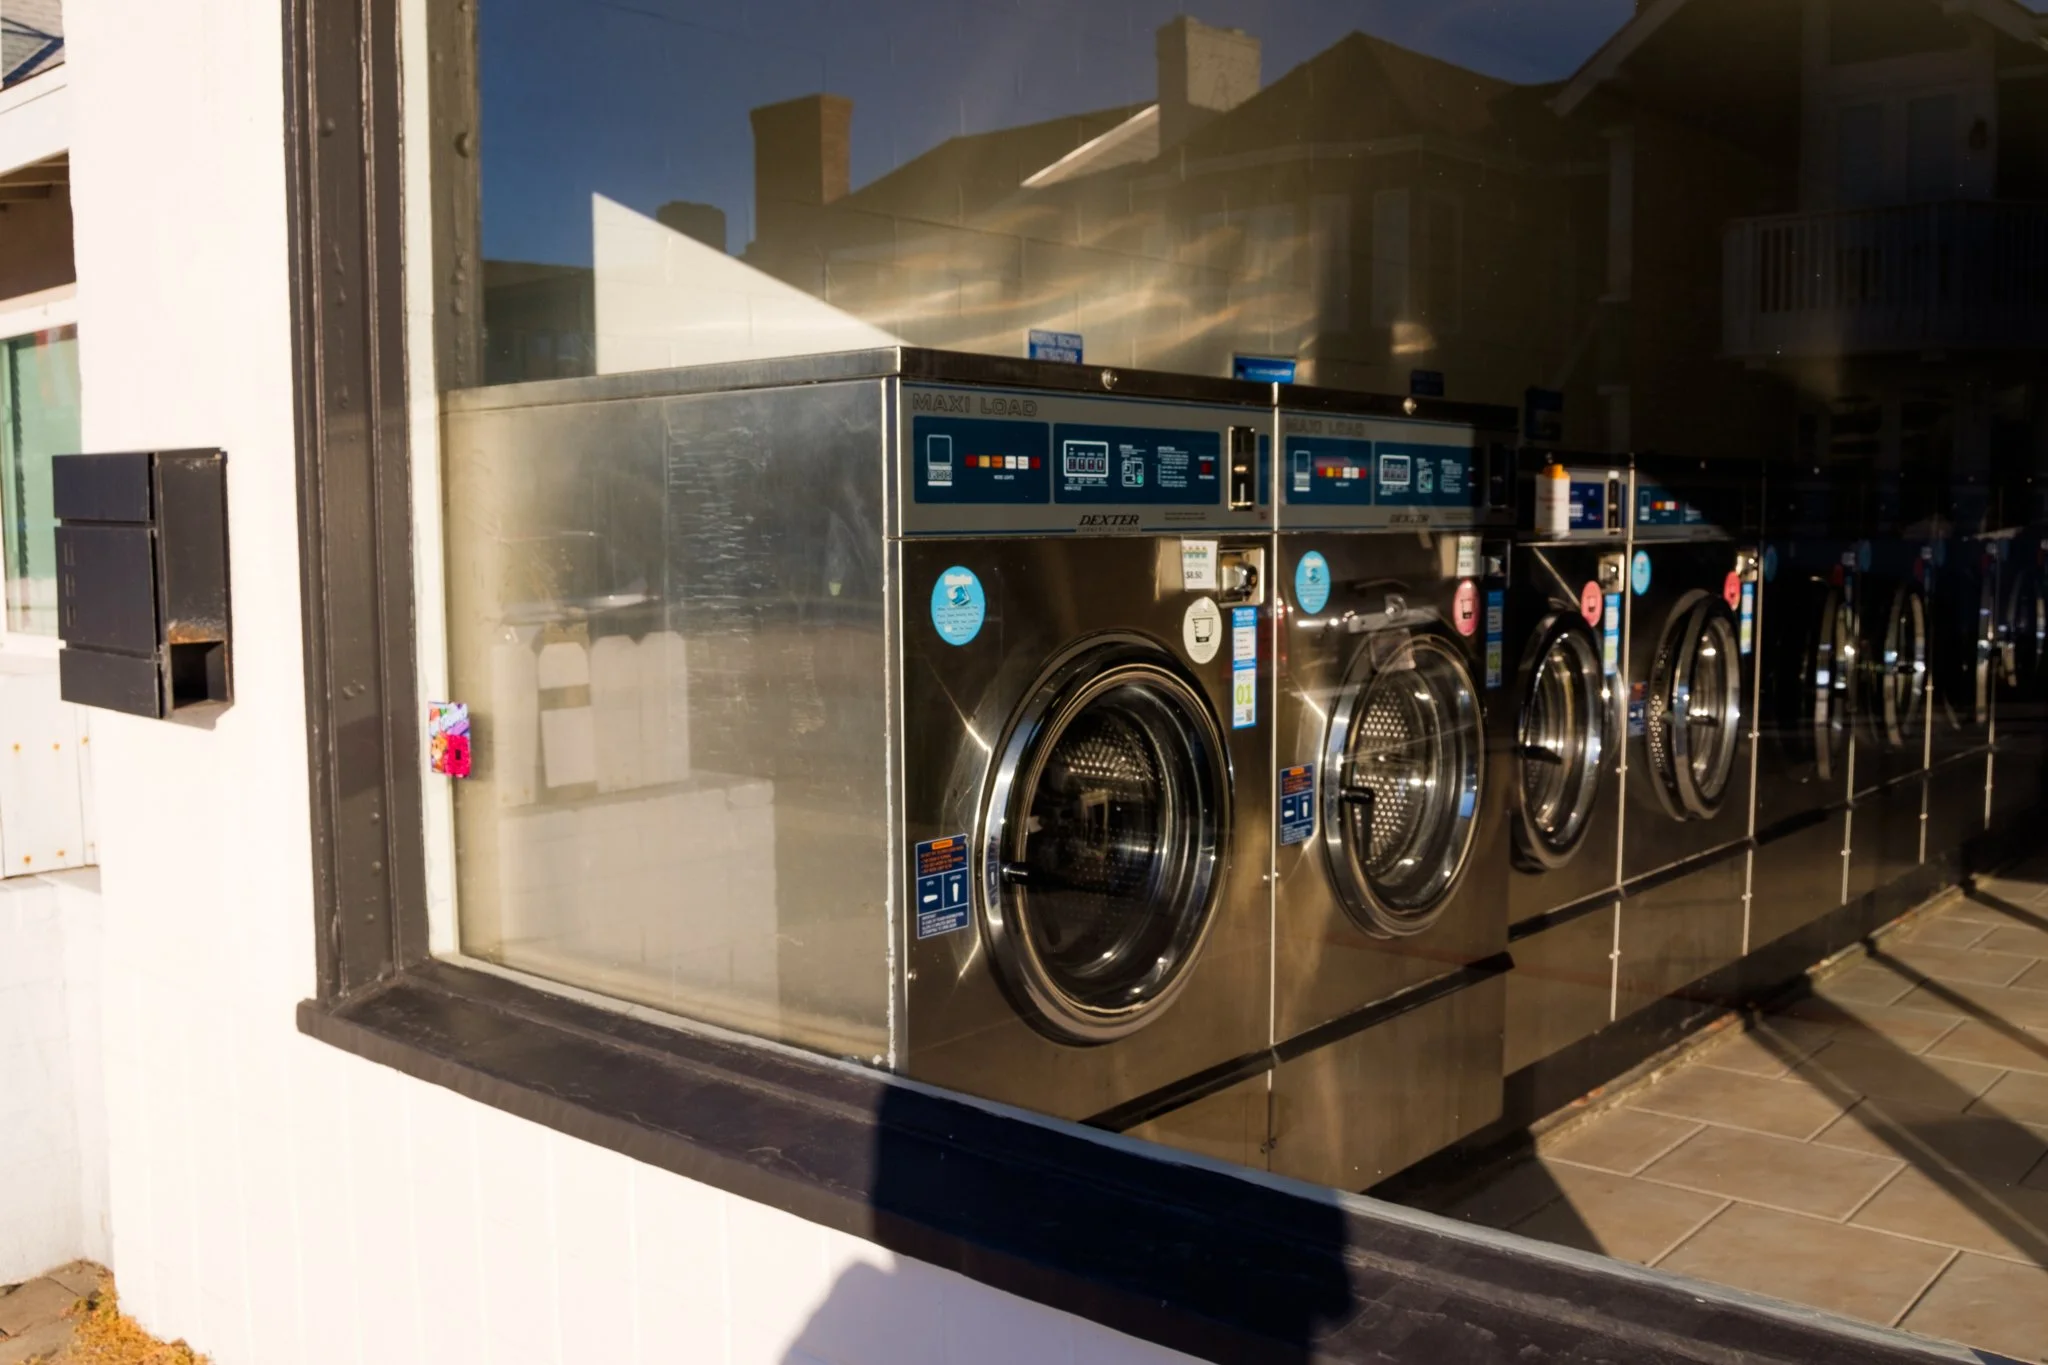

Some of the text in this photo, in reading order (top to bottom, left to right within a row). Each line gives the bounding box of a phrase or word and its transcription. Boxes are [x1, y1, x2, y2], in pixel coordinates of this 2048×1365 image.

[912, 392, 1038, 417] MAXI LOAD
[1078, 513, 1141, 527] DEXTER
